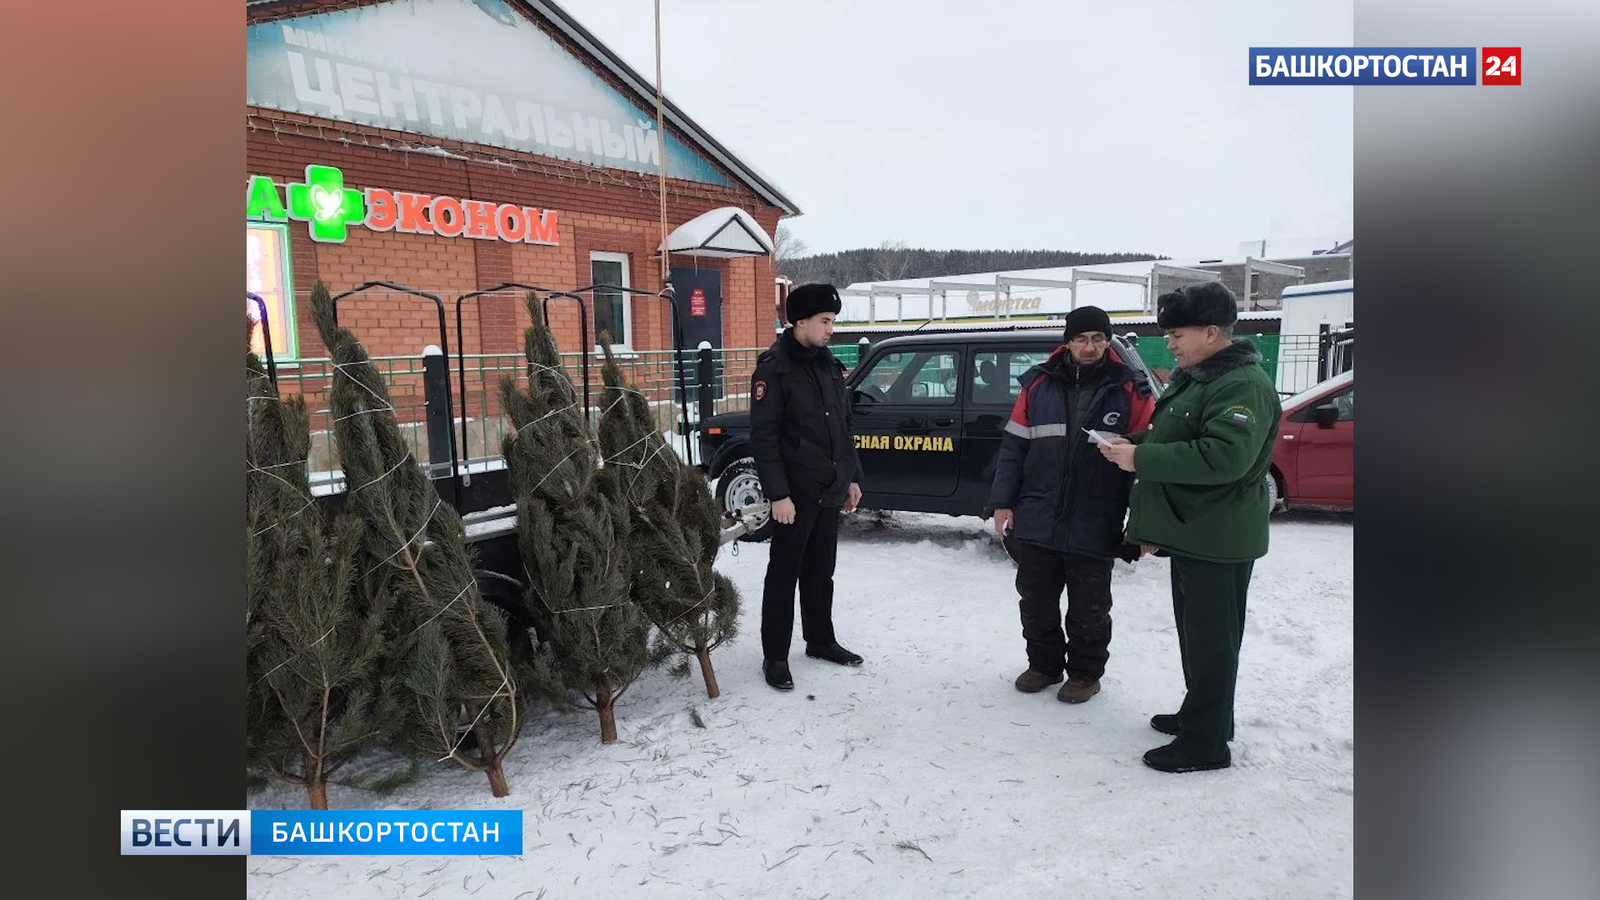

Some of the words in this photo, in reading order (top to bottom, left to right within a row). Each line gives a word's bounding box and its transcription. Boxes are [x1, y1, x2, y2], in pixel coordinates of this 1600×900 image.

[287, 50, 660, 166] ЦЕНТРАЛЬНЫЙ
[364, 187, 561, 246] ЭКОНОМ
[894, 435, 954, 452] ОХРАНА
